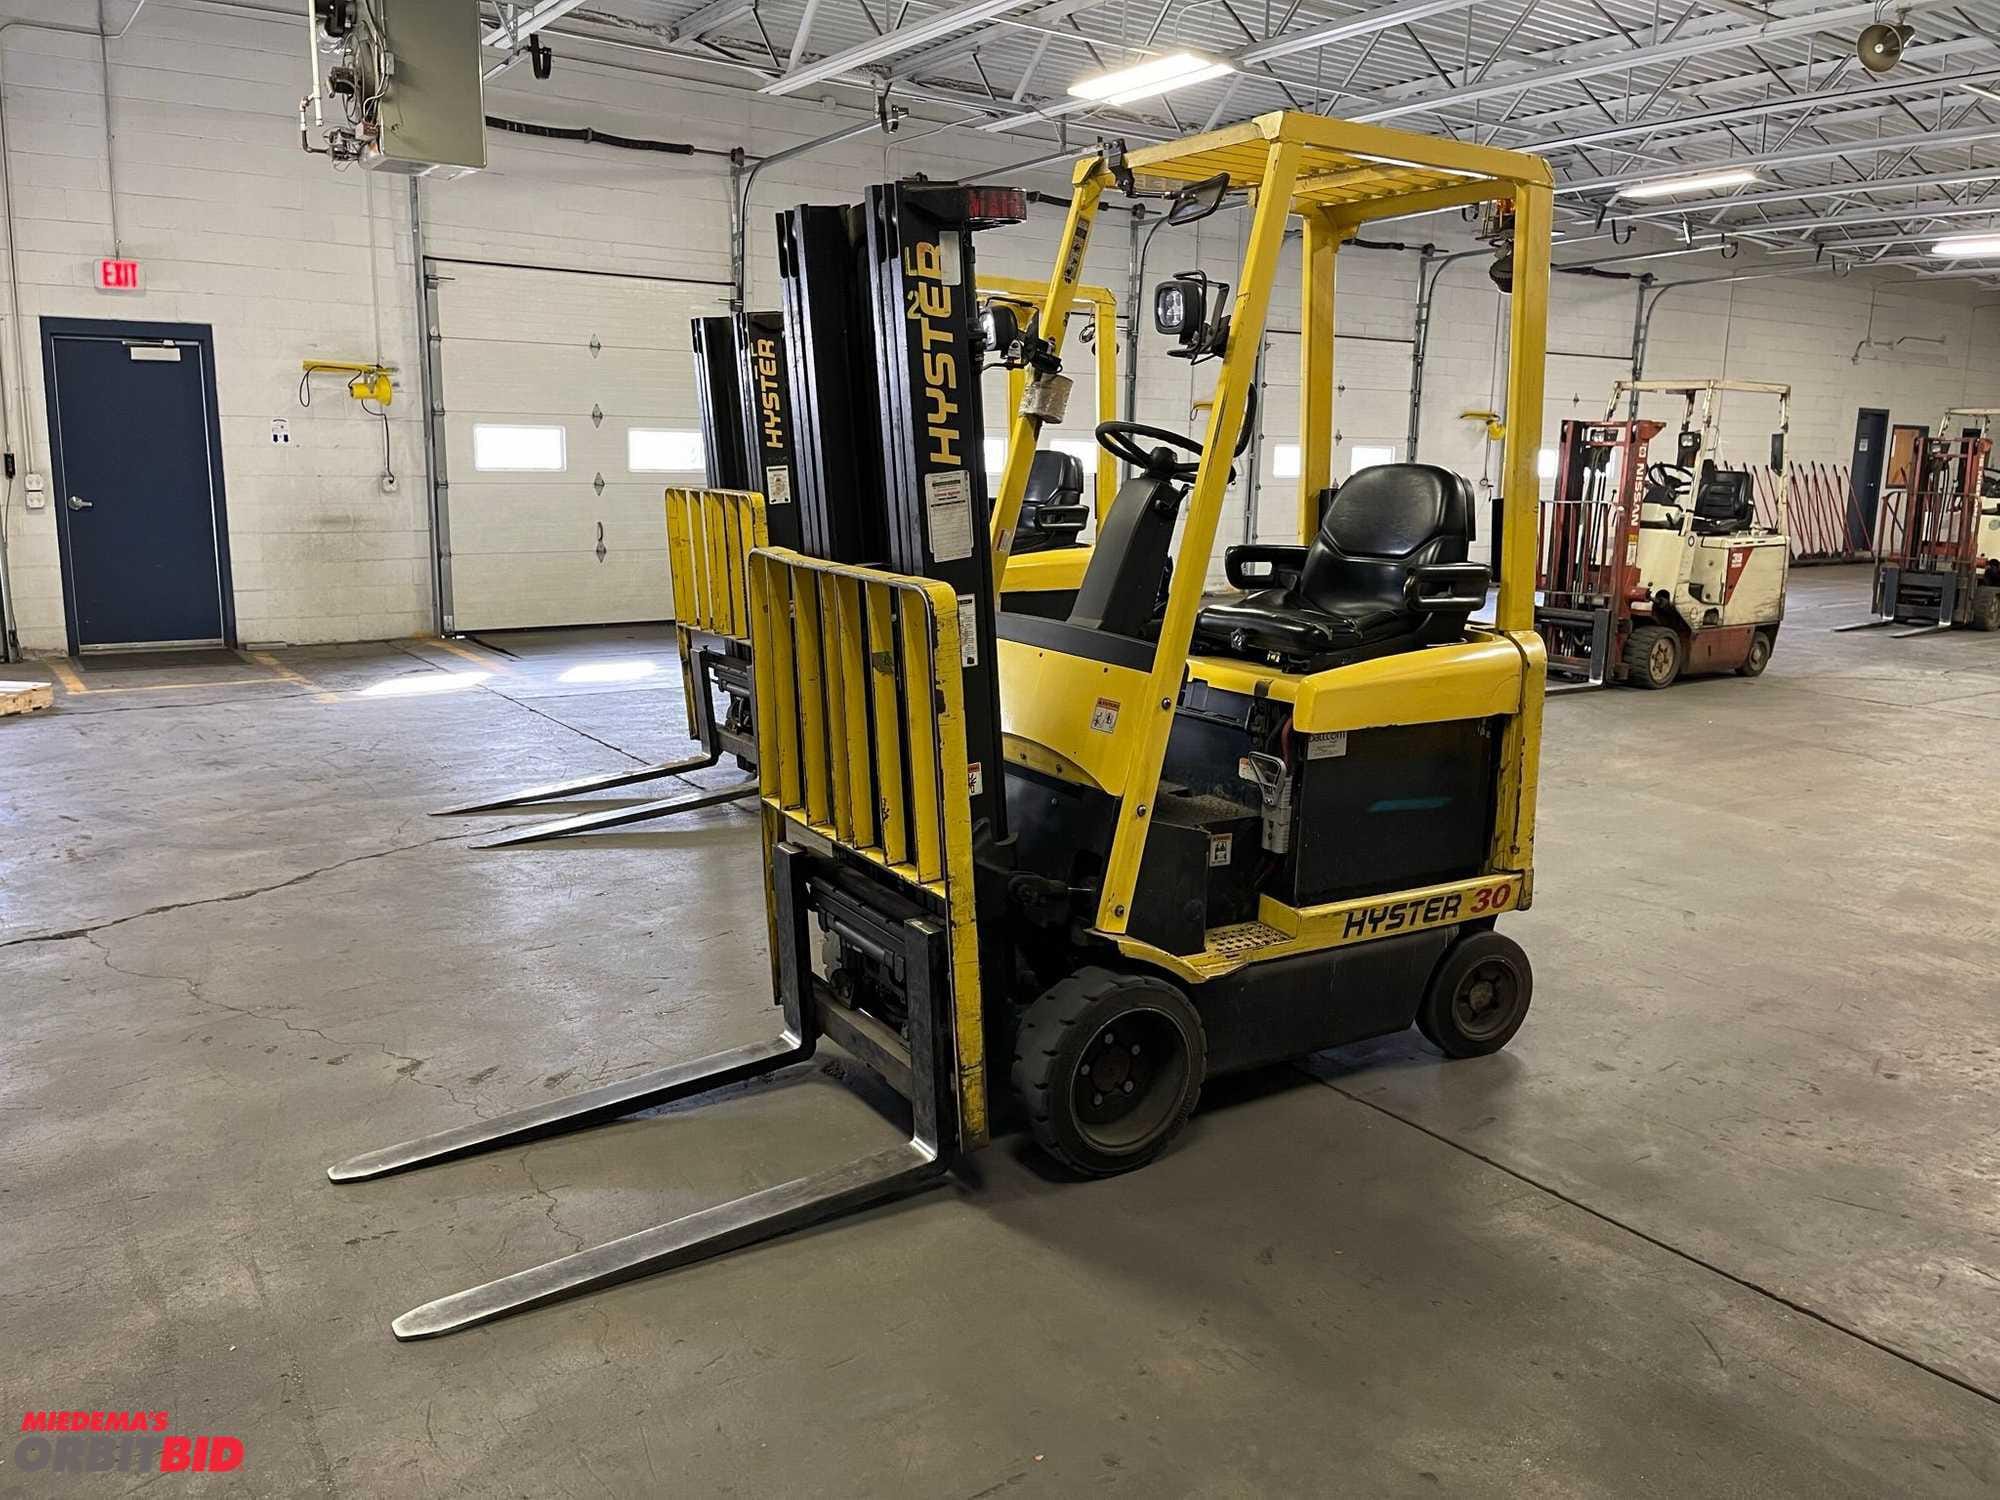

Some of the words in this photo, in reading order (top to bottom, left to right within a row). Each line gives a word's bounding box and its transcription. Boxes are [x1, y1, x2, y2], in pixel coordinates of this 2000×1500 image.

[102, 261, 137, 289] EXIT
[916, 240, 962, 466] HYSTER
[757, 338, 784, 449] HYSTER
[1630, 463, 1645, 526] NISSAN
[1342, 893, 1463, 939] HYSTER
[1470, 883, 1512, 914] 30
